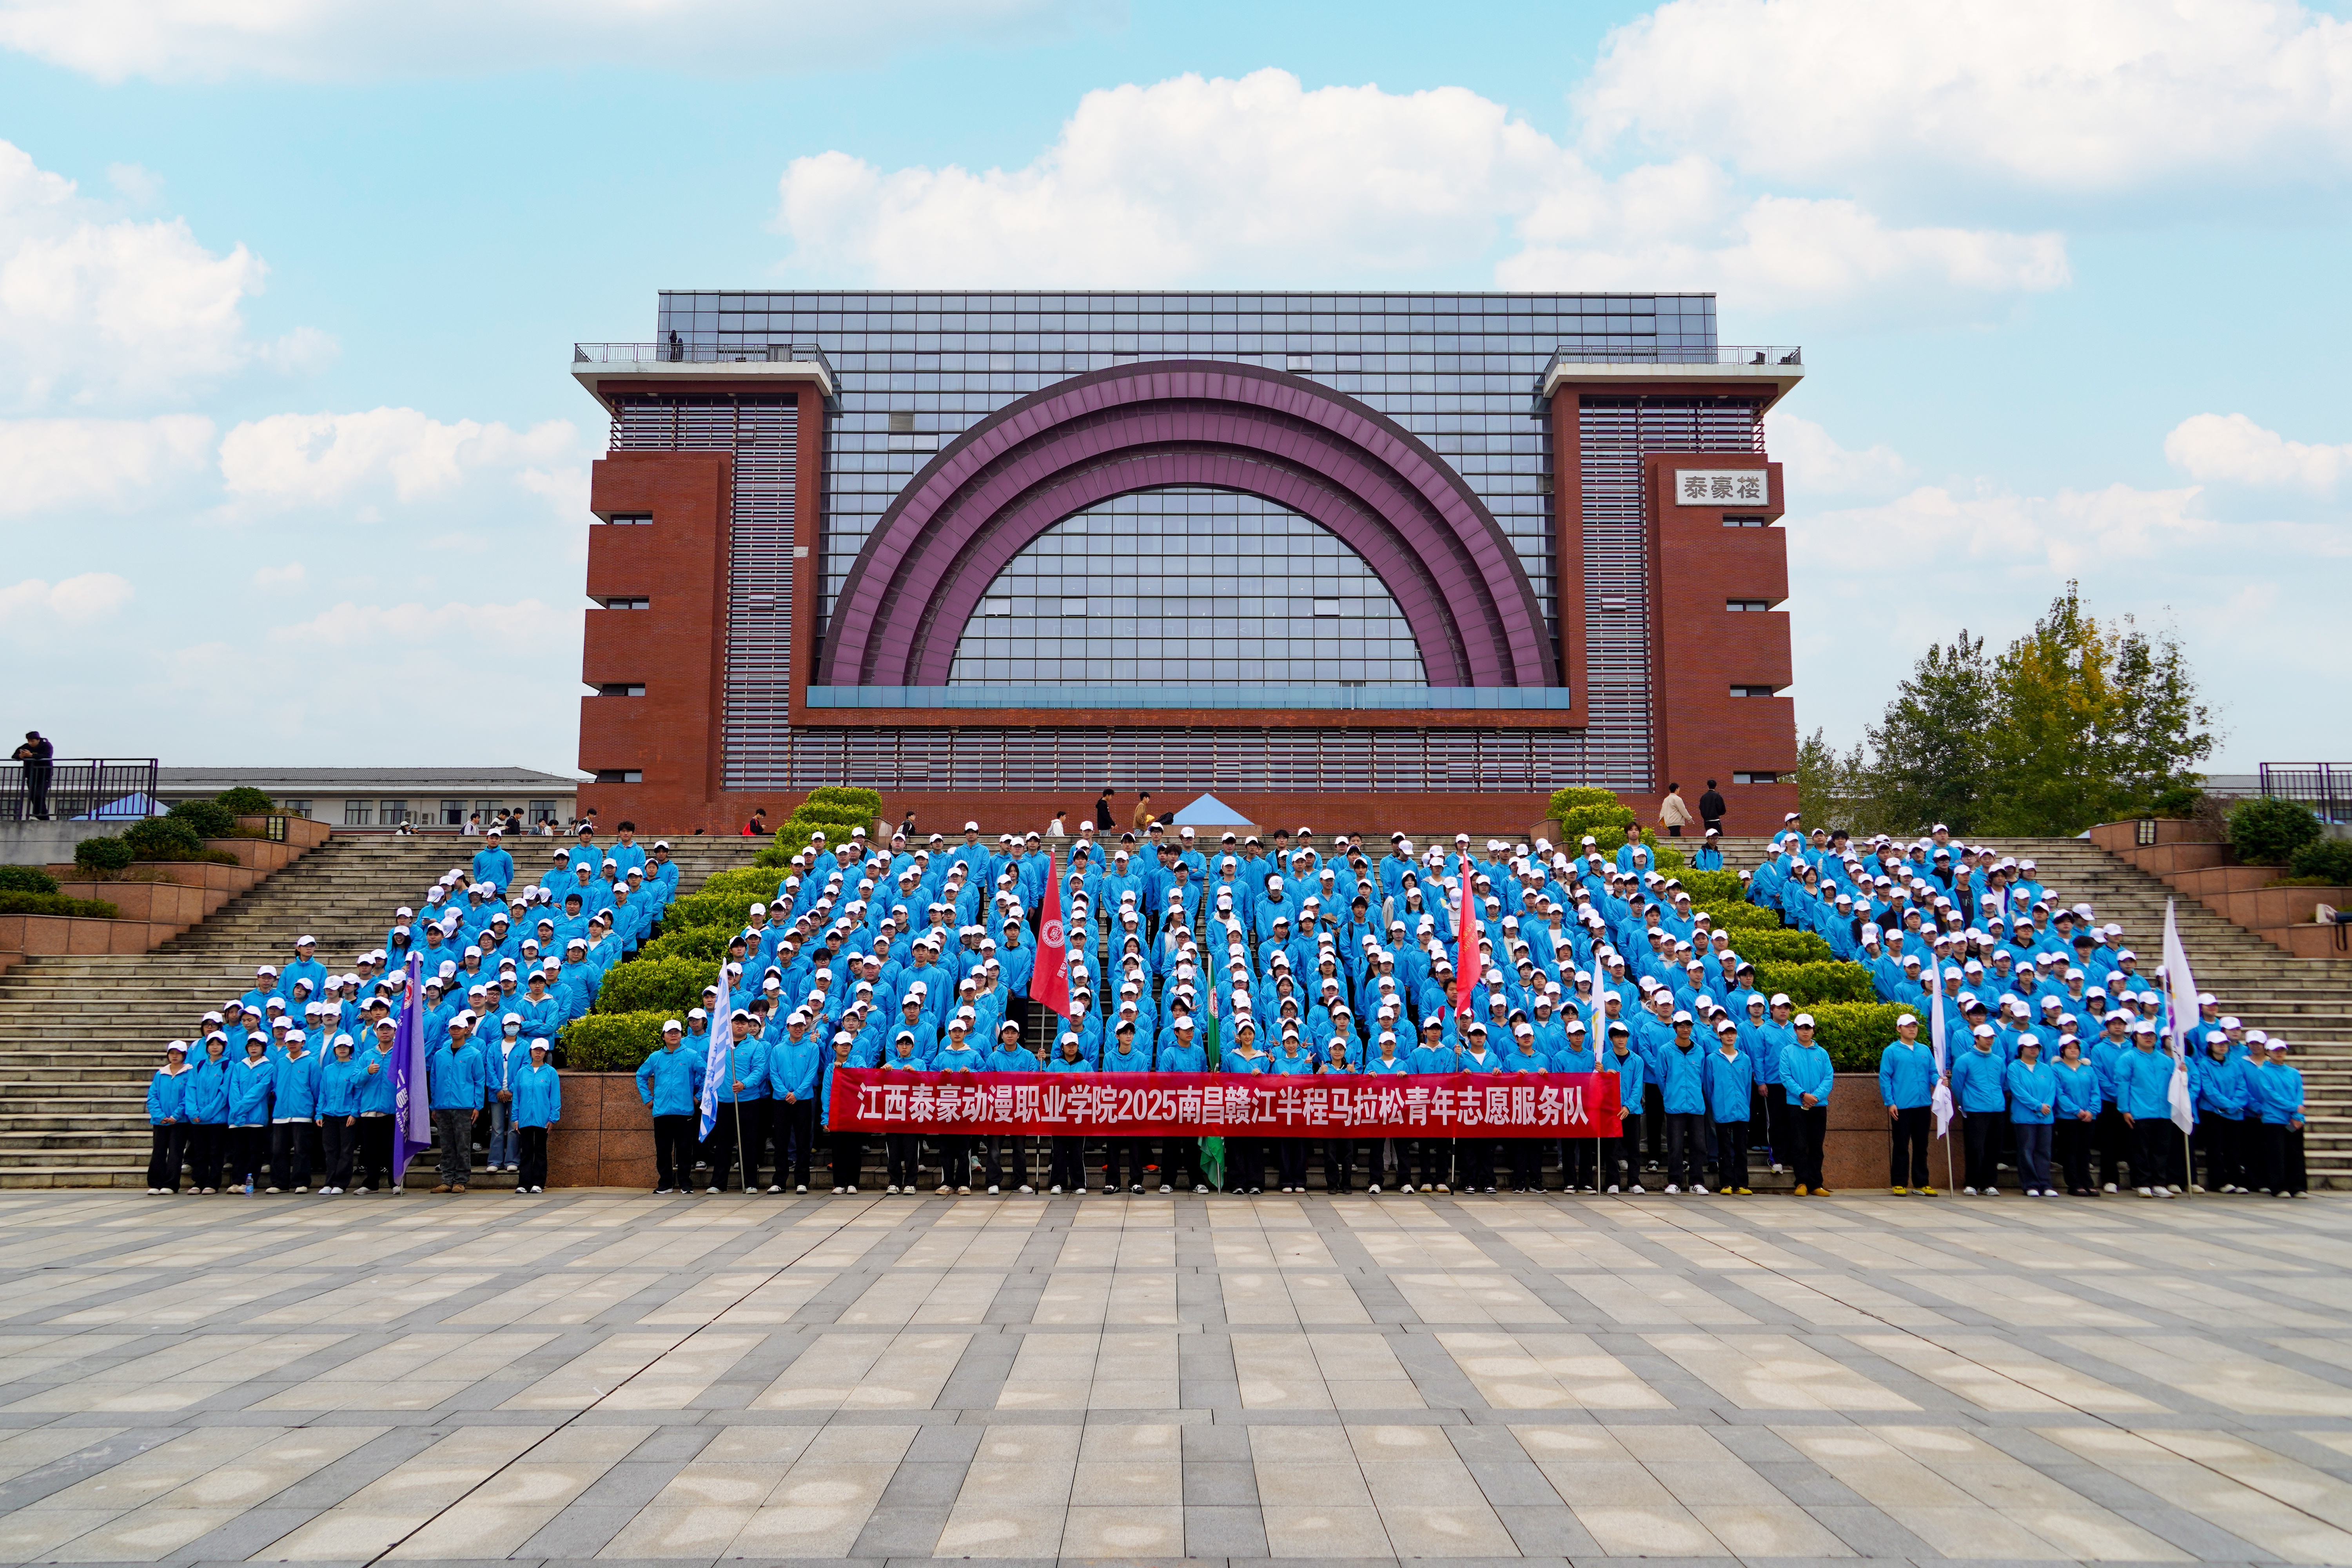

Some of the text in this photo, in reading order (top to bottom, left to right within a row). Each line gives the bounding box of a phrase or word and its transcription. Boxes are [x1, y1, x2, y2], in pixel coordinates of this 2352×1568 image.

[1684, 476, 1760, 499] 泰豪楼
[856, 1082, 1589, 1126] 江西泰豪动漫职业学院2025南昌赣江半程马拉松青年志愿服务队
